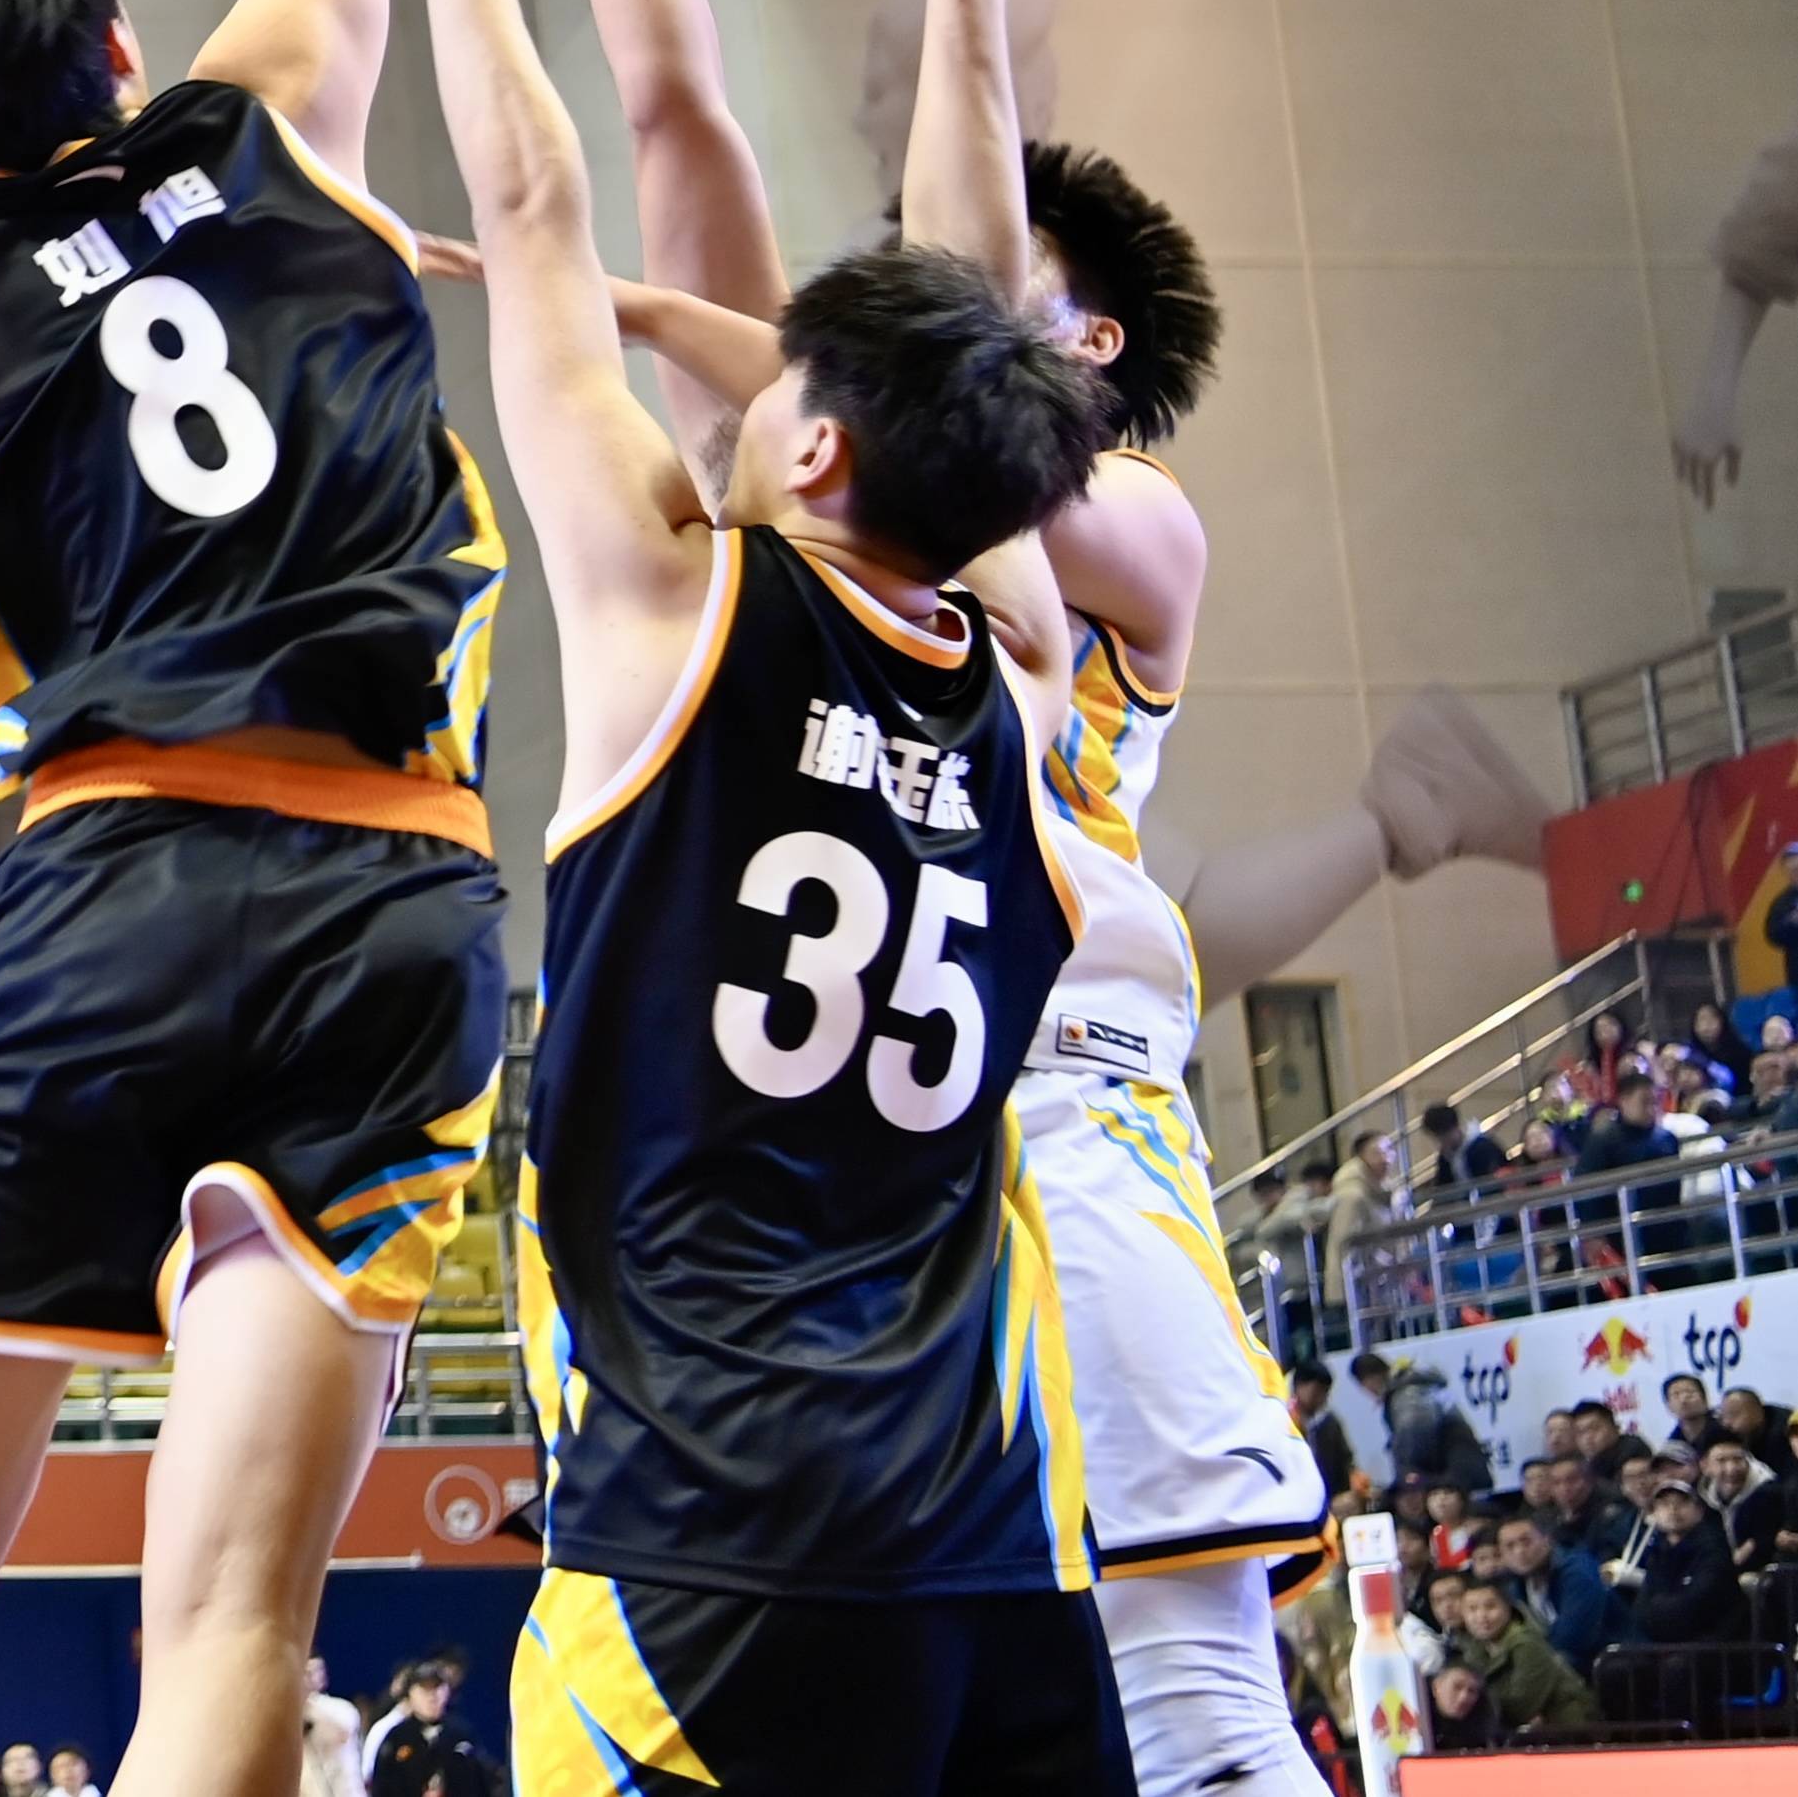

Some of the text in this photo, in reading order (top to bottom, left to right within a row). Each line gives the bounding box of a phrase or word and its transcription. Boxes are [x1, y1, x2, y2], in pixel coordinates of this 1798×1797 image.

[101, 275, 278, 518] 8
[711, 828, 991, 1134] 35
[1461, 1351, 1512, 1426] tcp
[1684, 1310, 1742, 1392] tcp
